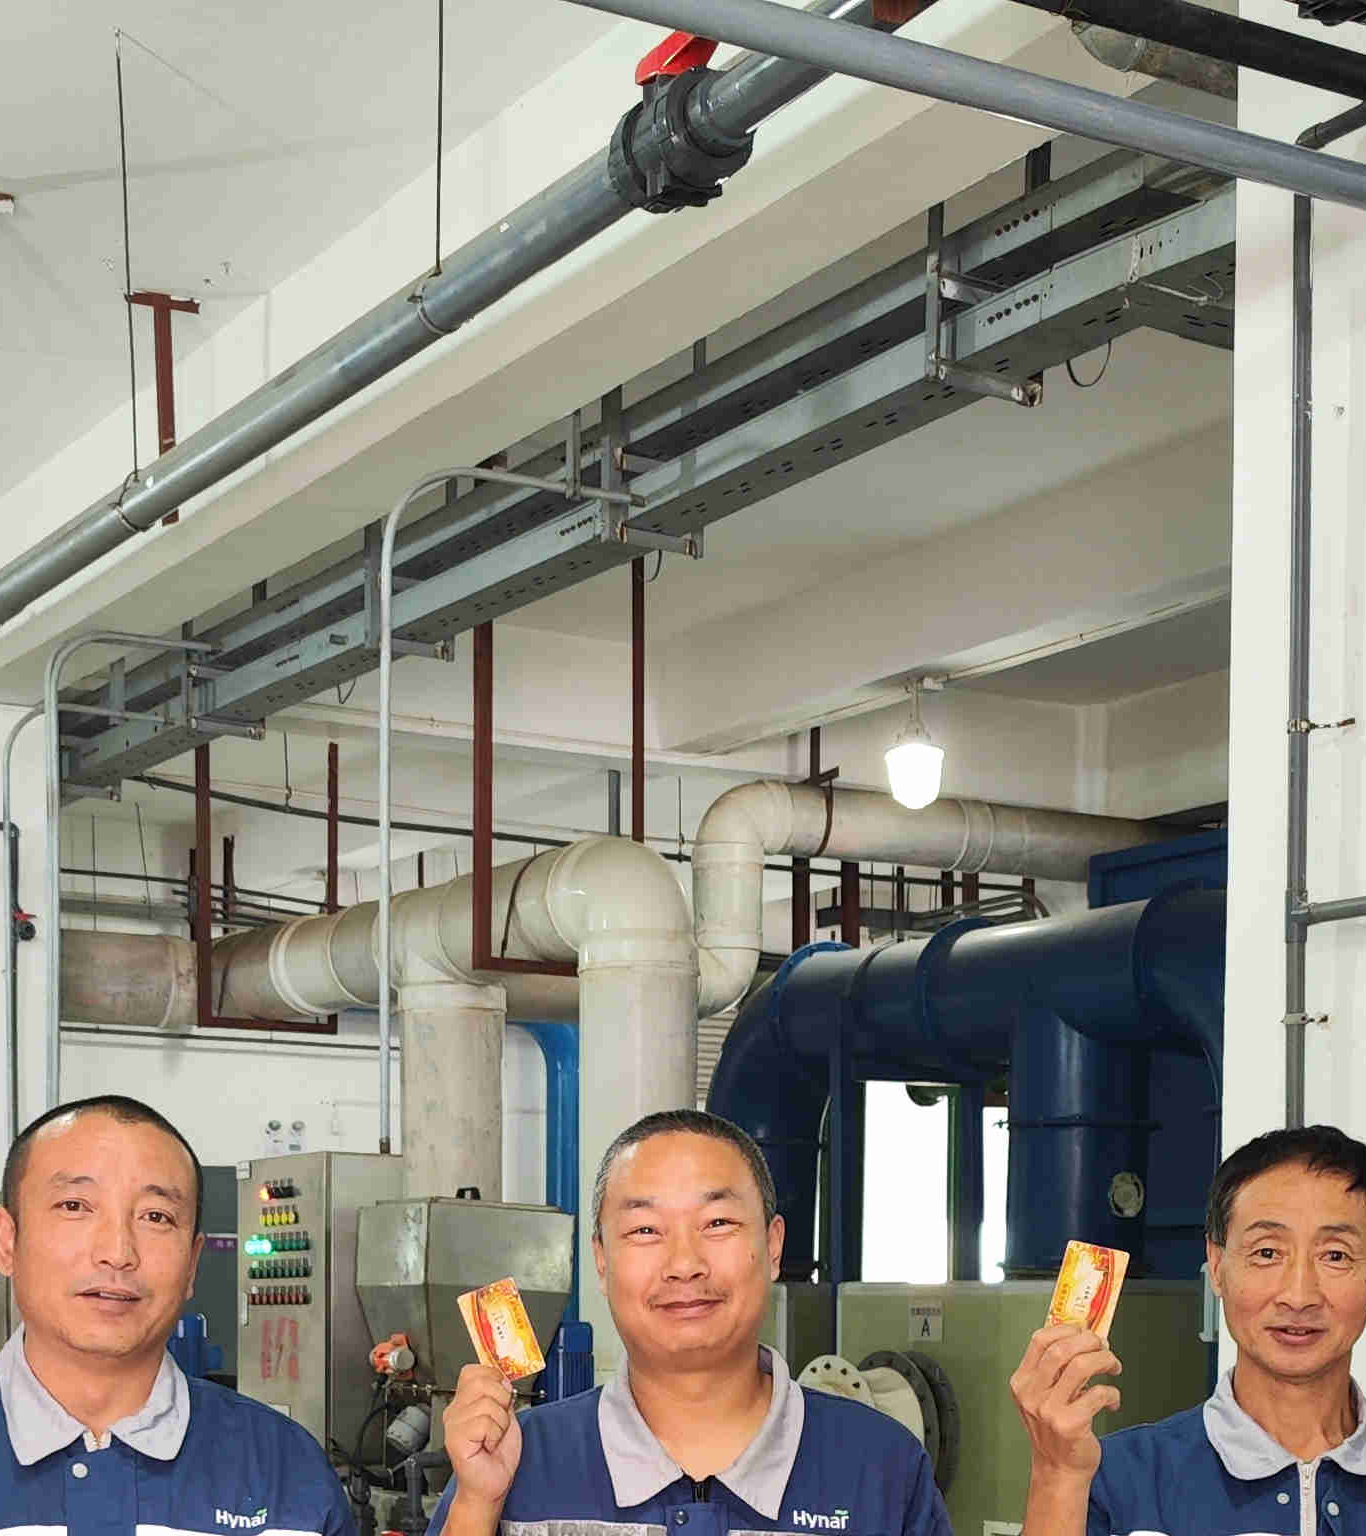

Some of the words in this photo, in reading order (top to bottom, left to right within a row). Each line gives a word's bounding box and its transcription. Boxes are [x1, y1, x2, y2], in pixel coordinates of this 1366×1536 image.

[921, 1317, 931, 1337] A
[215, 1508, 268, 1529] Hynar
[793, 1509, 849, 1530] Hynar
